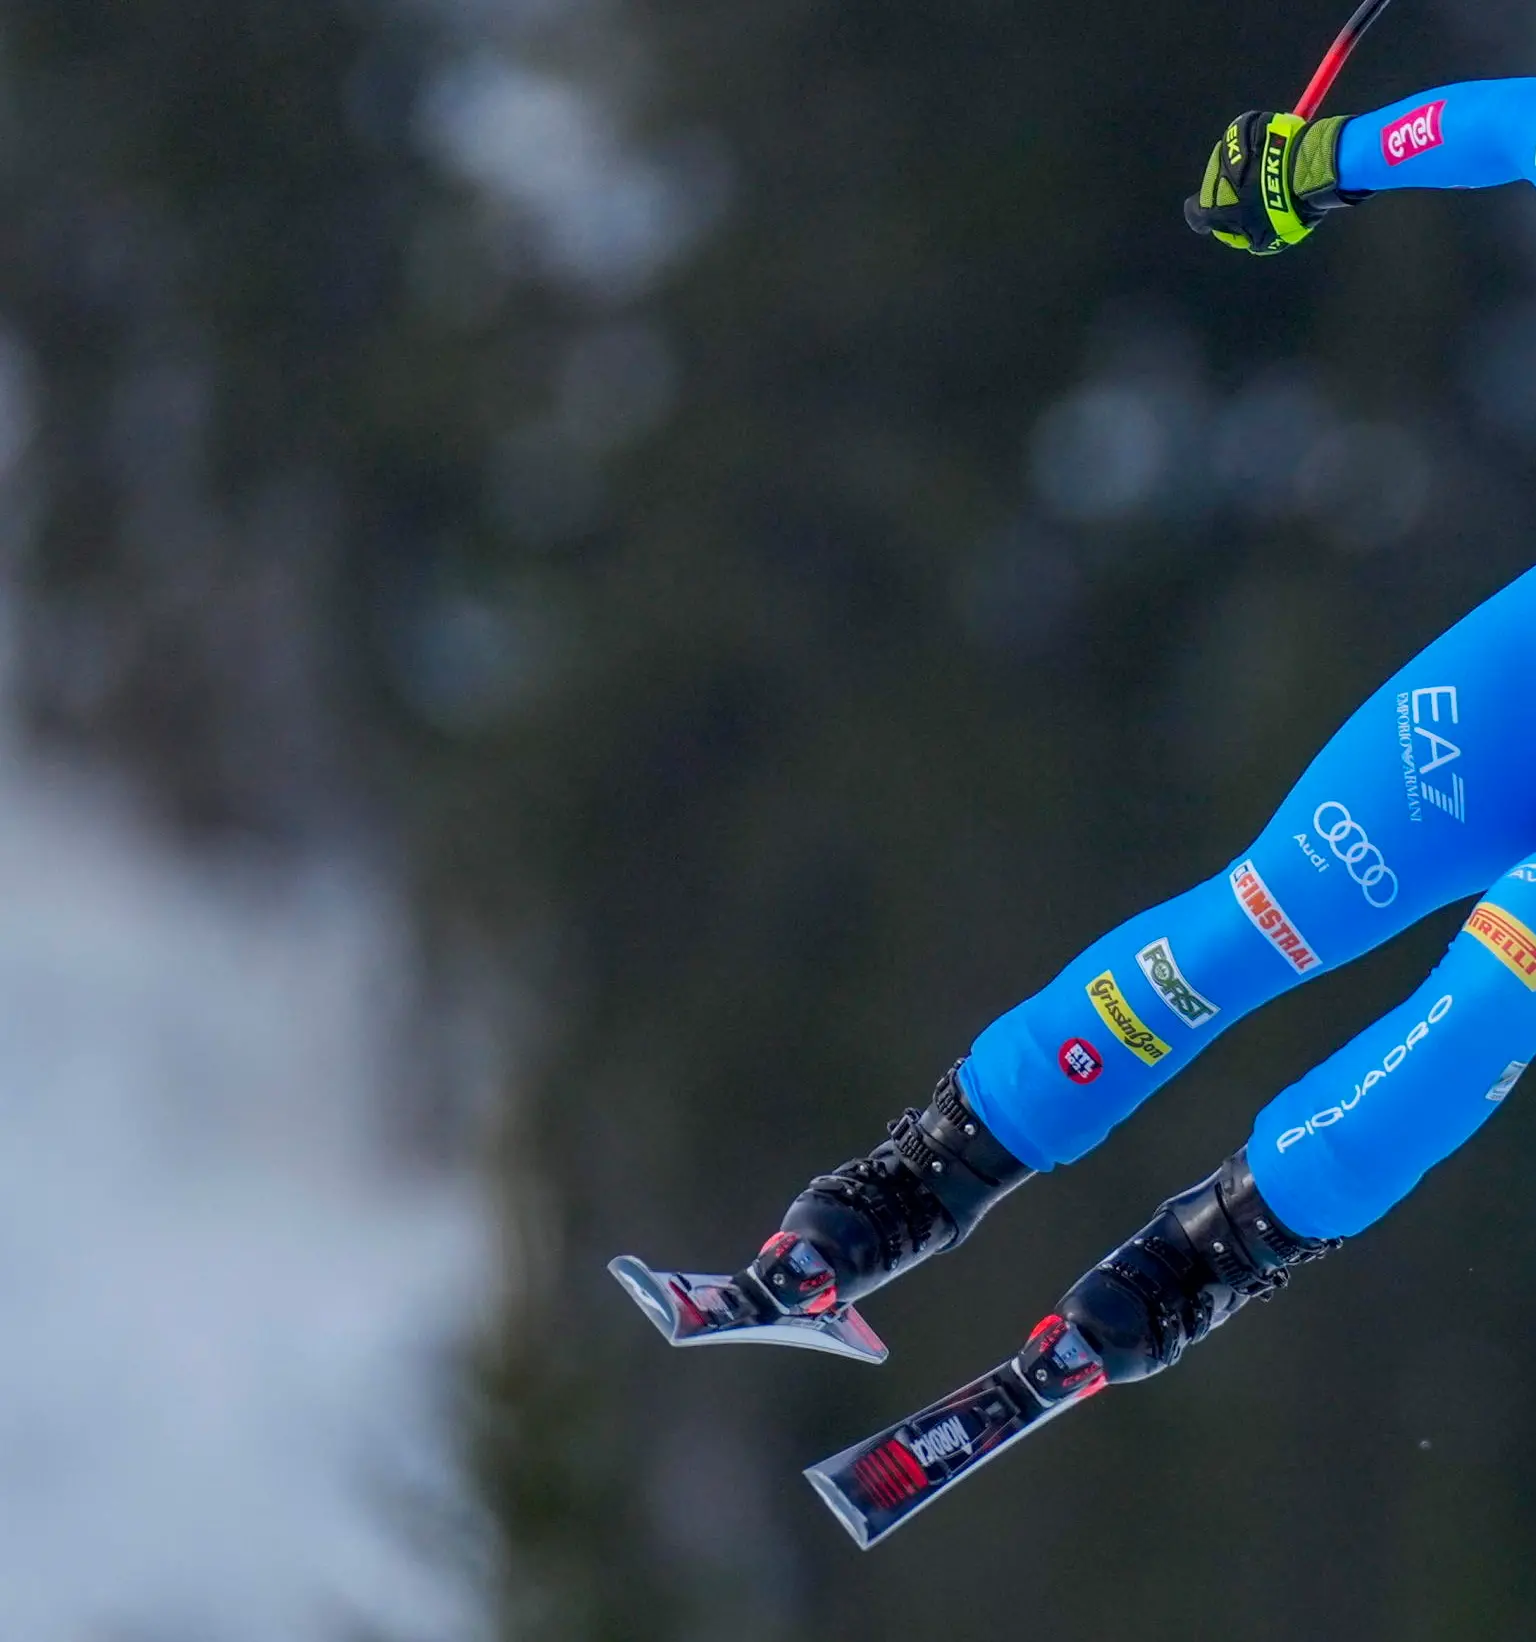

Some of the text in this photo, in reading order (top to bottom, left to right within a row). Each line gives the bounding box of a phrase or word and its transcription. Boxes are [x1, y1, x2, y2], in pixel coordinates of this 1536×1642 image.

[1226, 125, 1242, 165] EKI
[1388, 105, 1435, 158] enel
[1265, 147, 1283, 209] LEKI
[1396, 692, 1422, 822] EMPORIO ARMANI
[1293, 833, 1330, 873] Audi
[1237, 872, 1314, 970] FINSTRAL
[1142, 944, 1215, 1021] FORST
[1090, 978, 1163, 1059] GrissinBon
[1070, 1043, 1095, 1072] RTL
[1276, 994, 1453, 1153] PIQUADRO
